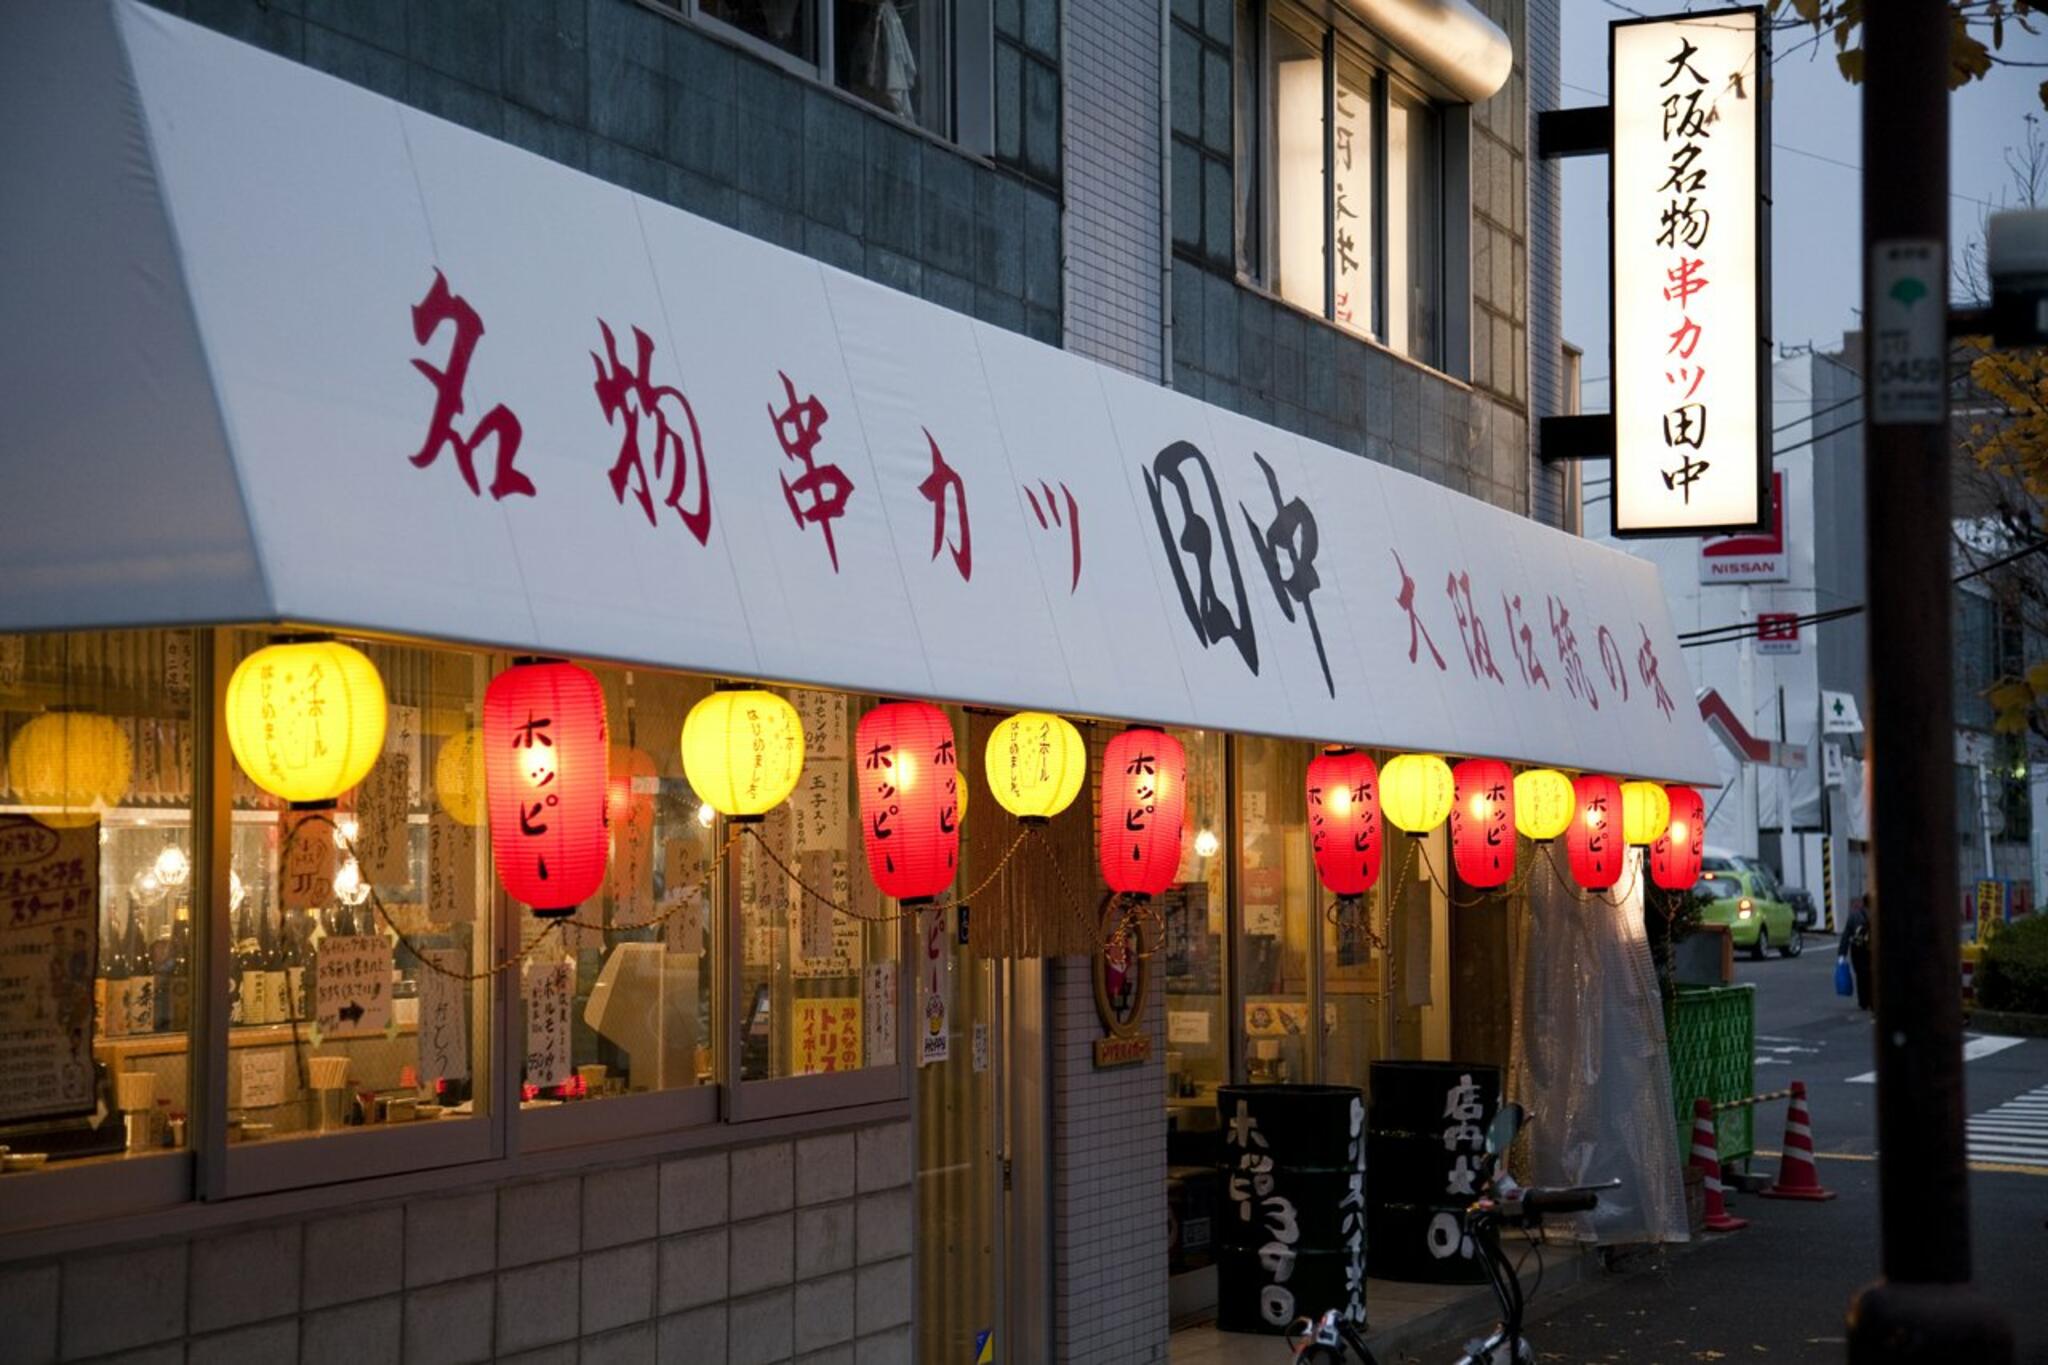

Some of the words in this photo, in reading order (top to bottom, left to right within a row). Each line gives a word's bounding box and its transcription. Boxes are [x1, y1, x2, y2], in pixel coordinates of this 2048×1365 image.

[1656, 37, 1710, 504] 大阪名物串カツ田中
[408, 265, 1081, 594] 名物串カツ
[1711, 562, 1775, 575] NISSAN
[512, 708, 559, 880] ホッピー
[866, 739, 898, 874] ホッピー
[1126, 748, 1155, 861] ホッピー
[1351, 780, 1375, 877] ホッピー
[1486, 782, 1507, 869] ホッピー
[1587, 795, 1609, 873] ホッピー
[841, 1007, 857, 1069] みんなの
